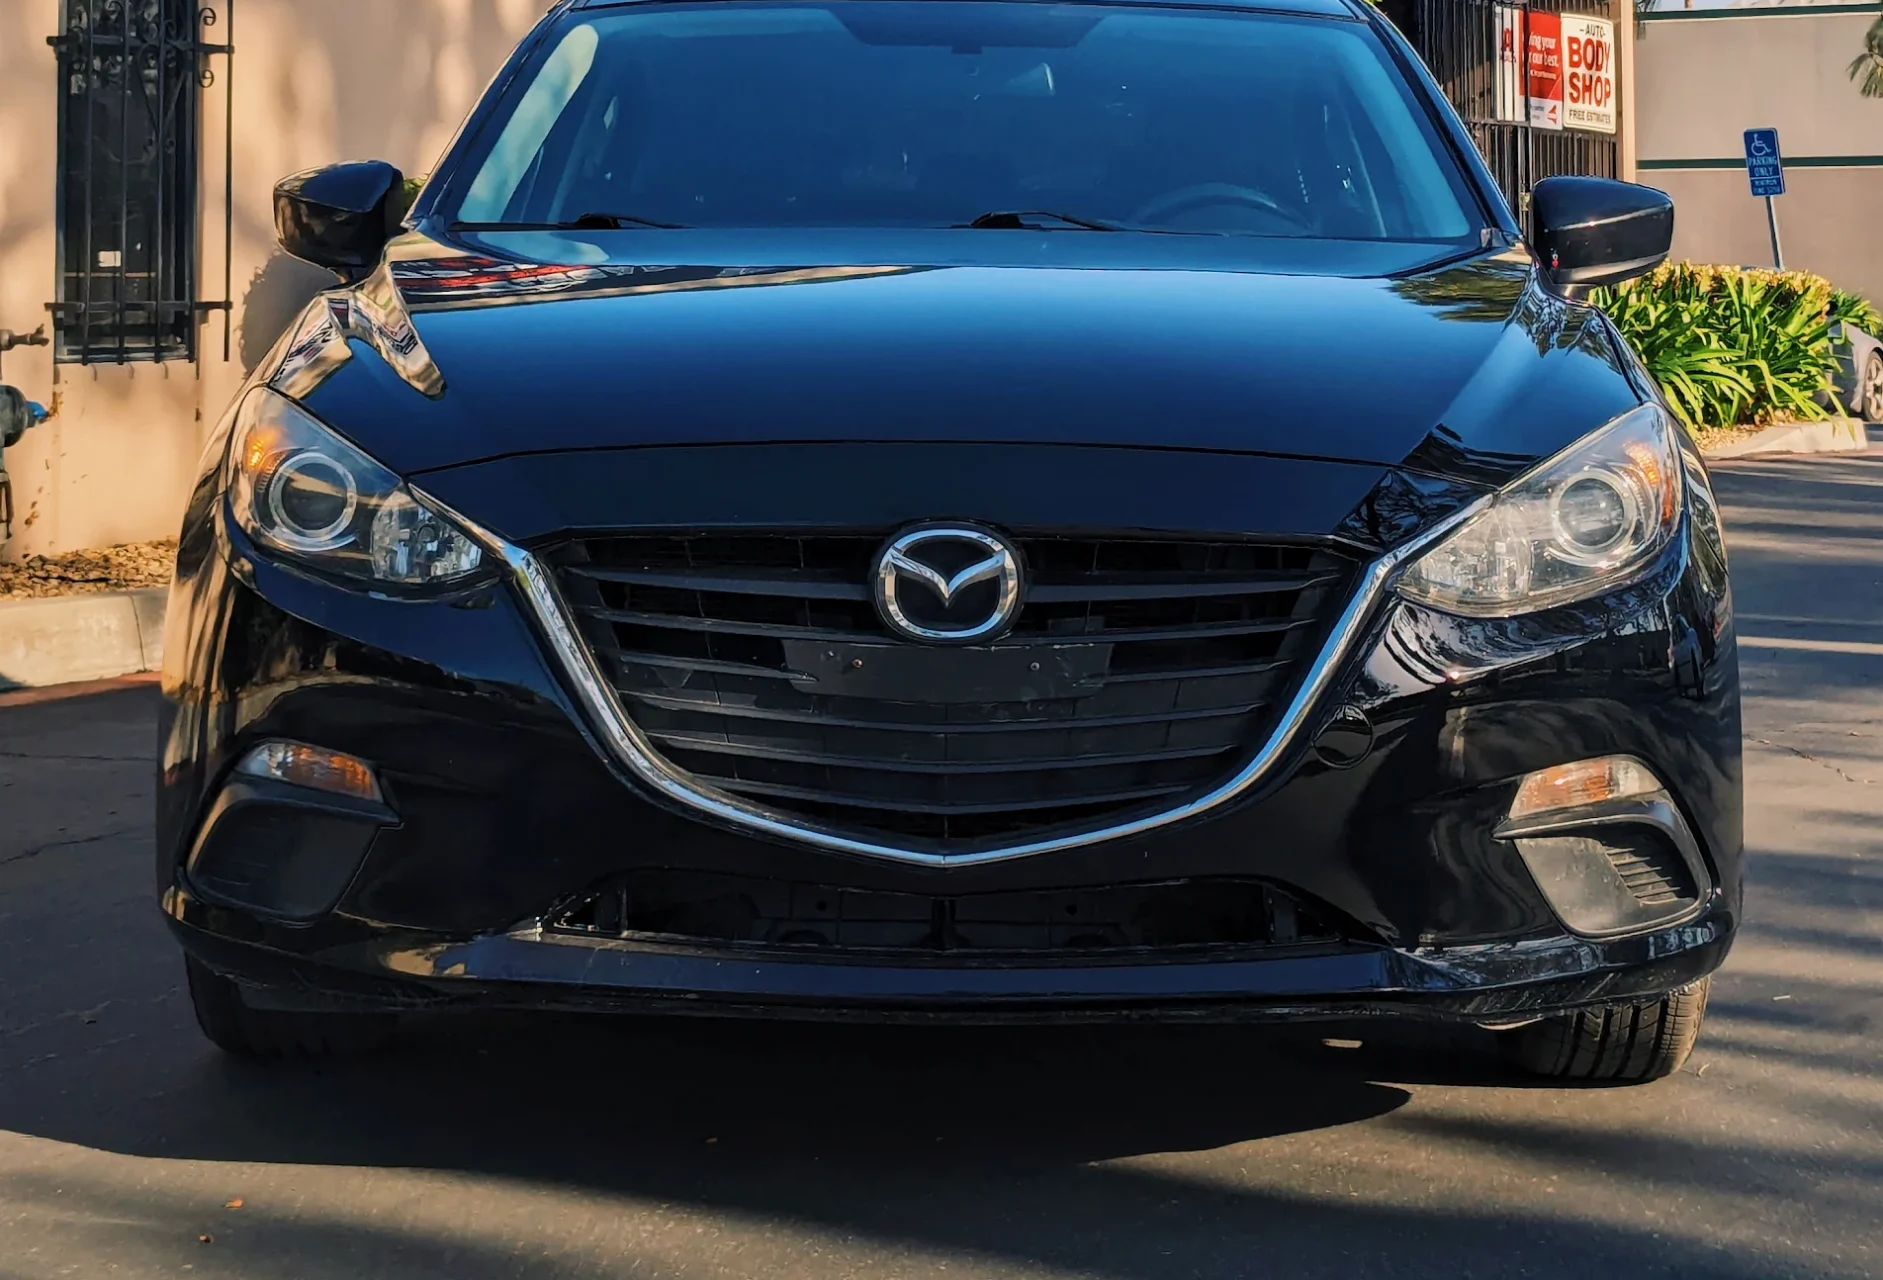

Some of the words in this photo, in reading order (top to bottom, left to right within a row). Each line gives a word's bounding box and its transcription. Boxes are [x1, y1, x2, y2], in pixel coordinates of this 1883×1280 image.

[1567, 35, 1611, 74] BODY
[1568, 71, 1611, 108] SHOP
[1748, 156, 1778, 166] PARKING
[1754, 166, 1773, 177] ONLY
